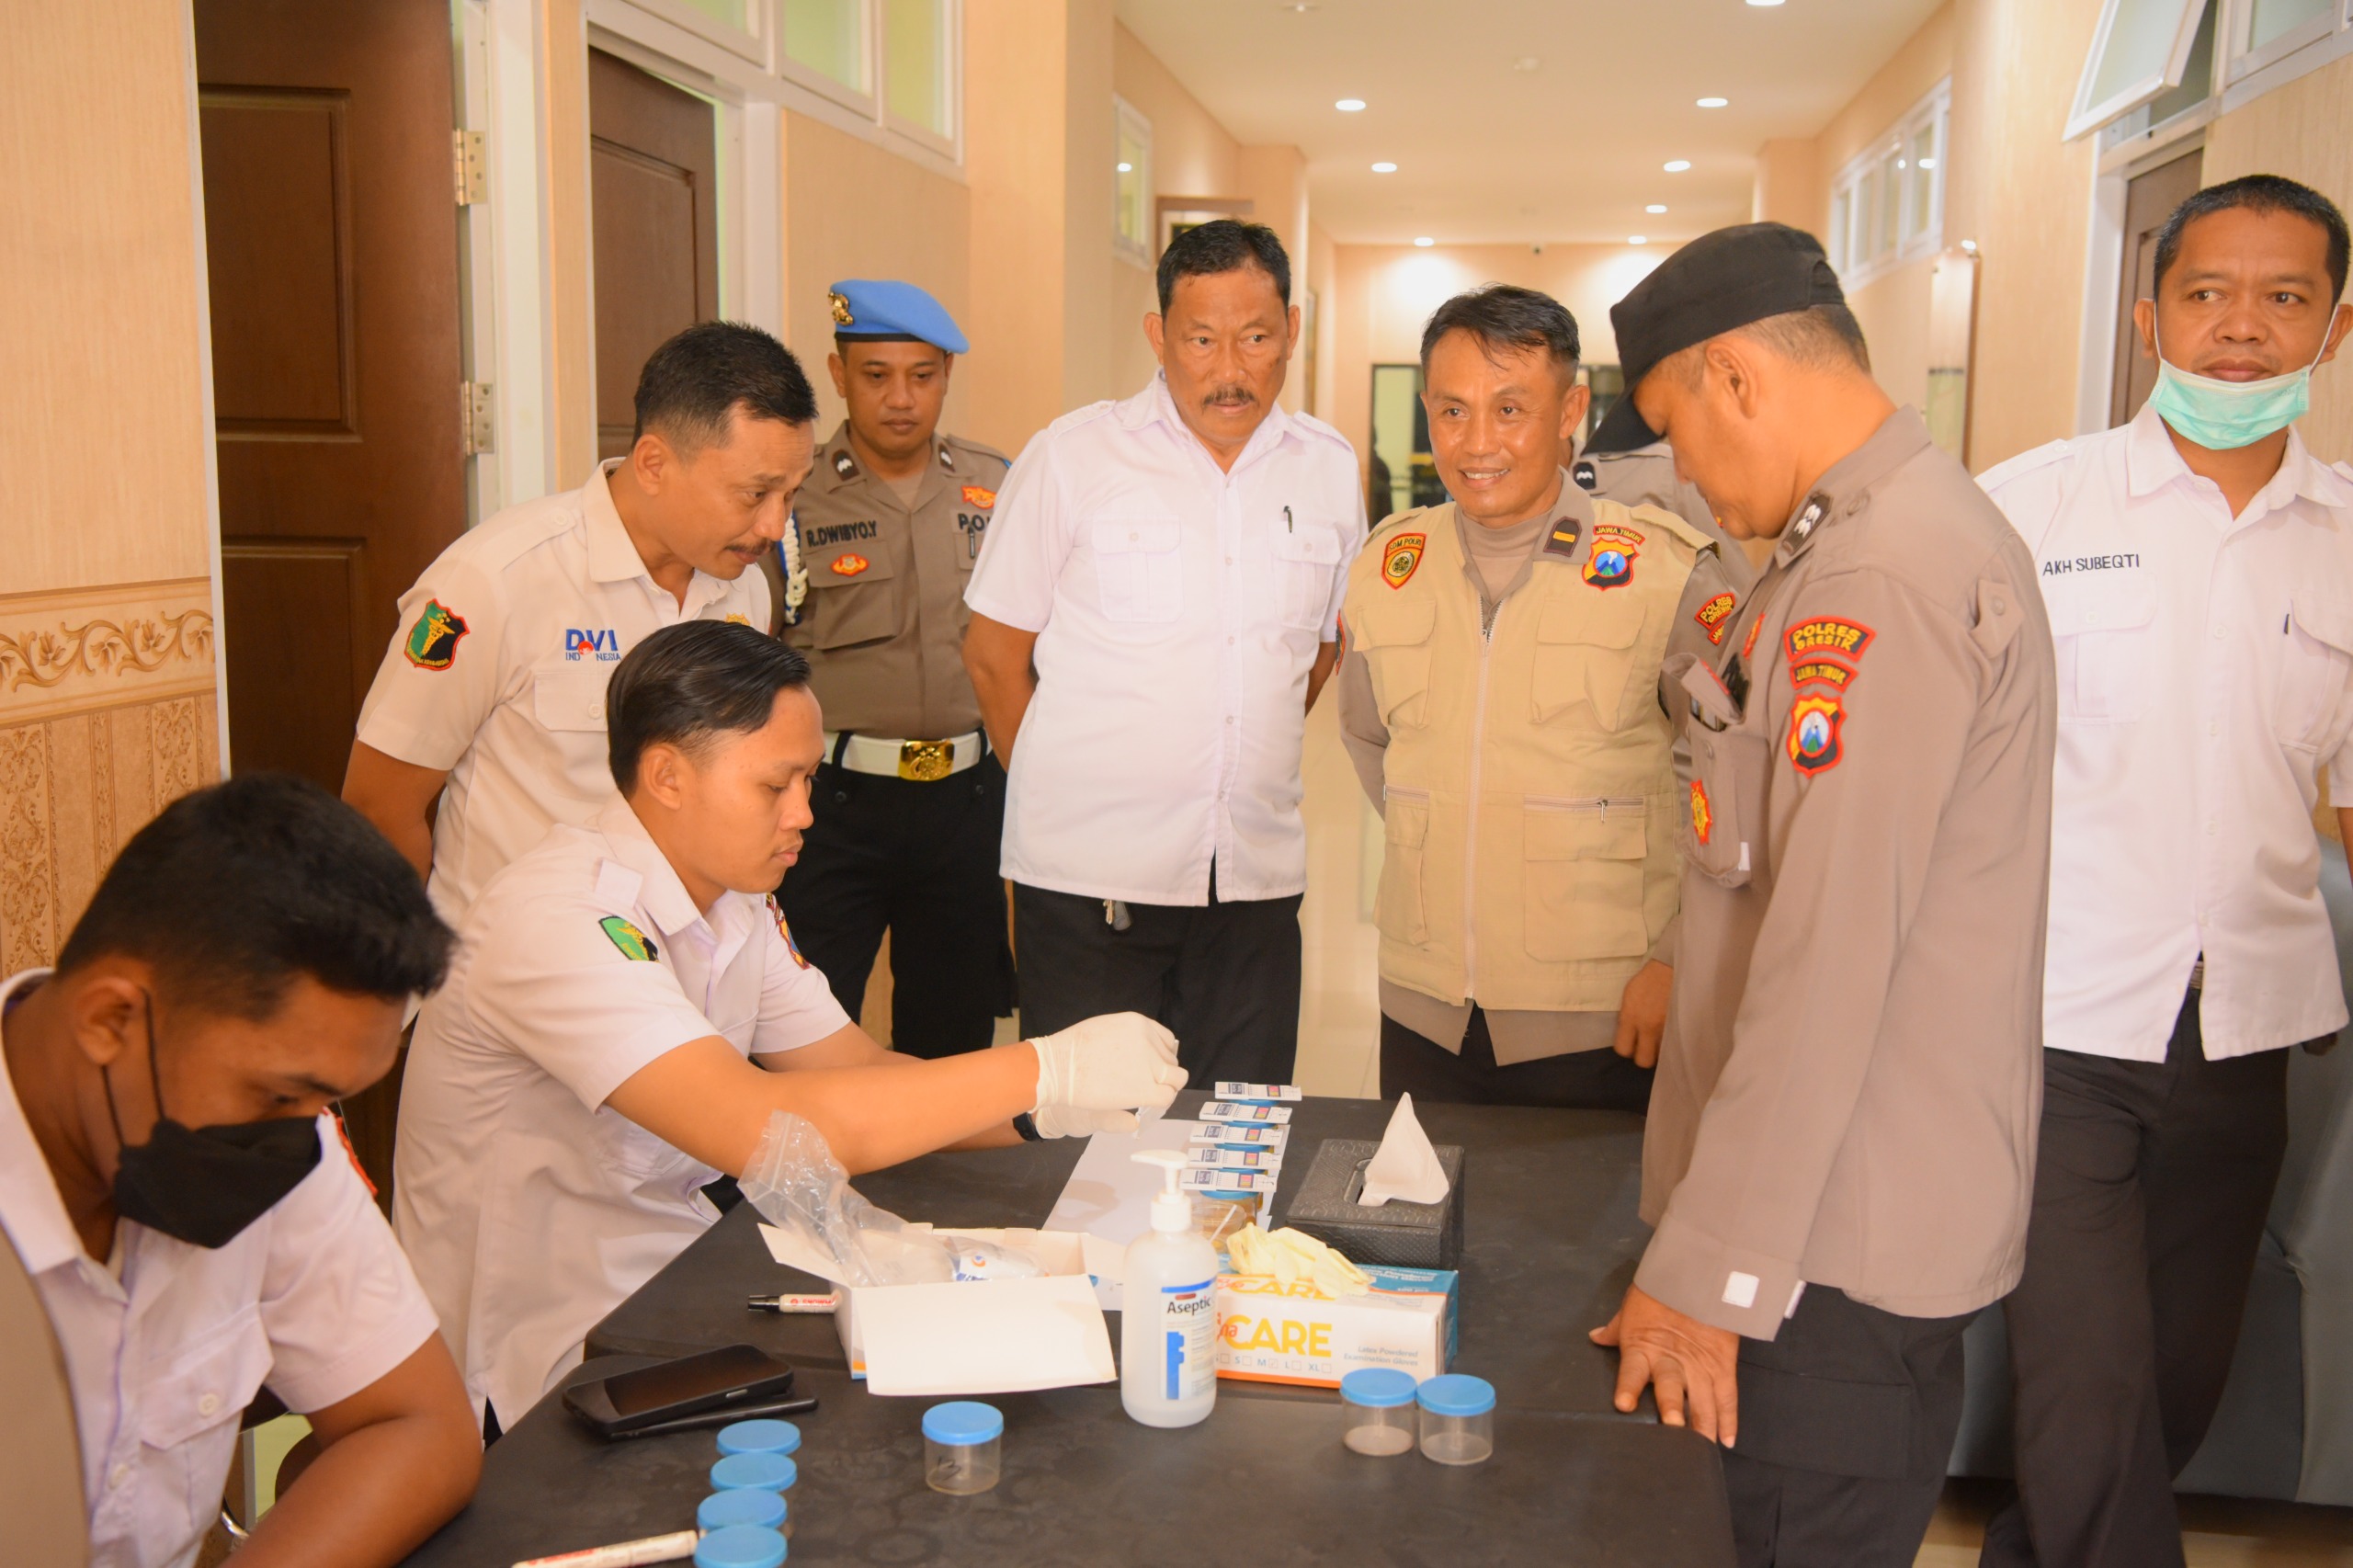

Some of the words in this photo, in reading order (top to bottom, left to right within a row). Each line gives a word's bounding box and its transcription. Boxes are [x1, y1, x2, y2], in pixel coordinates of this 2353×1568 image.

[958, 513, 991, 532] PO
[1404, 538, 1423, 547] POLRI
[1620, 528, 1643, 544] TIMUR
[2042, 559, 2073, 576] AKH
[2075, 553, 2140, 572] SUBEQTI
[565, 629, 619, 652] DVI
[1792, 622, 1862, 644] POLRES
[1795, 635, 1851, 652] GRESIK
[1166, 1295, 1211, 1316] Aseptic
[1223, 1314, 1333, 1358] CARE
[1344, 1353, 1391, 1364] Examination
[1392, 1358, 1418, 1367] Gloves
[1358, 1346, 1377, 1354] Latex
[1379, 1346, 1418, 1358] Powdered
[1257, 1358, 1267, 1367] M
[1309, 1362, 1320, 1372] XL
